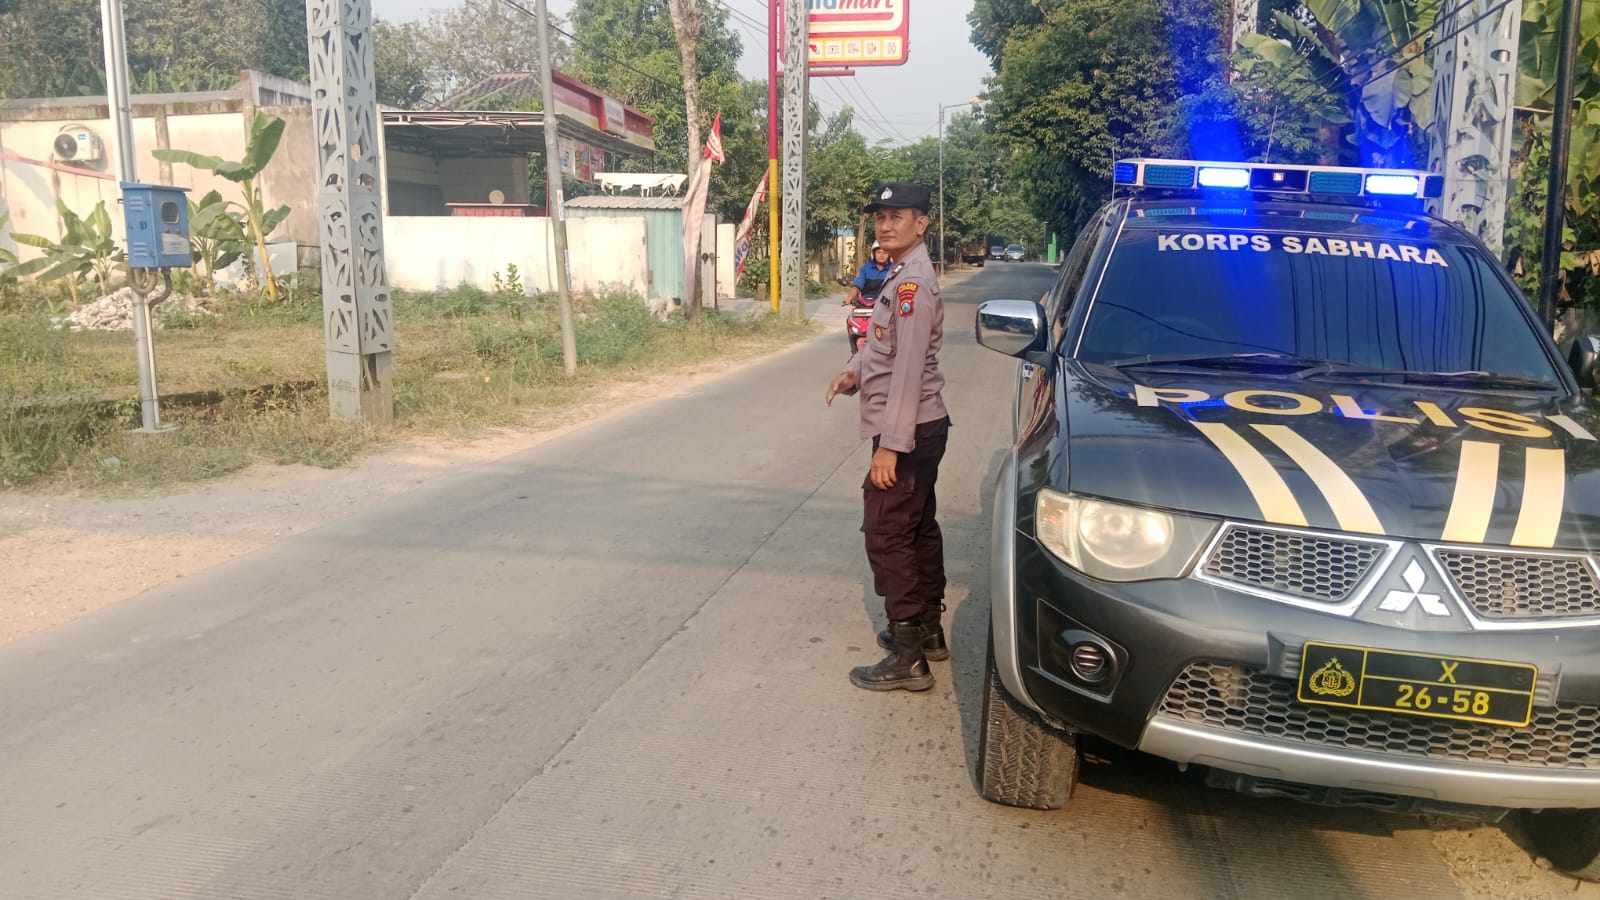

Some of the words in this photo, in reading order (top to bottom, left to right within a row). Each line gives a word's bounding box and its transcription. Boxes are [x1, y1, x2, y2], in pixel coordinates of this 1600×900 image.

[1158, 234, 1272, 252] KORPS
[1282, 235, 1449, 267] SABHARA
[1134, 384, 1599, 442] POLISI
[1438, 661, 1460, 684] X
[1395, 684, 1490, 716] 26-58
